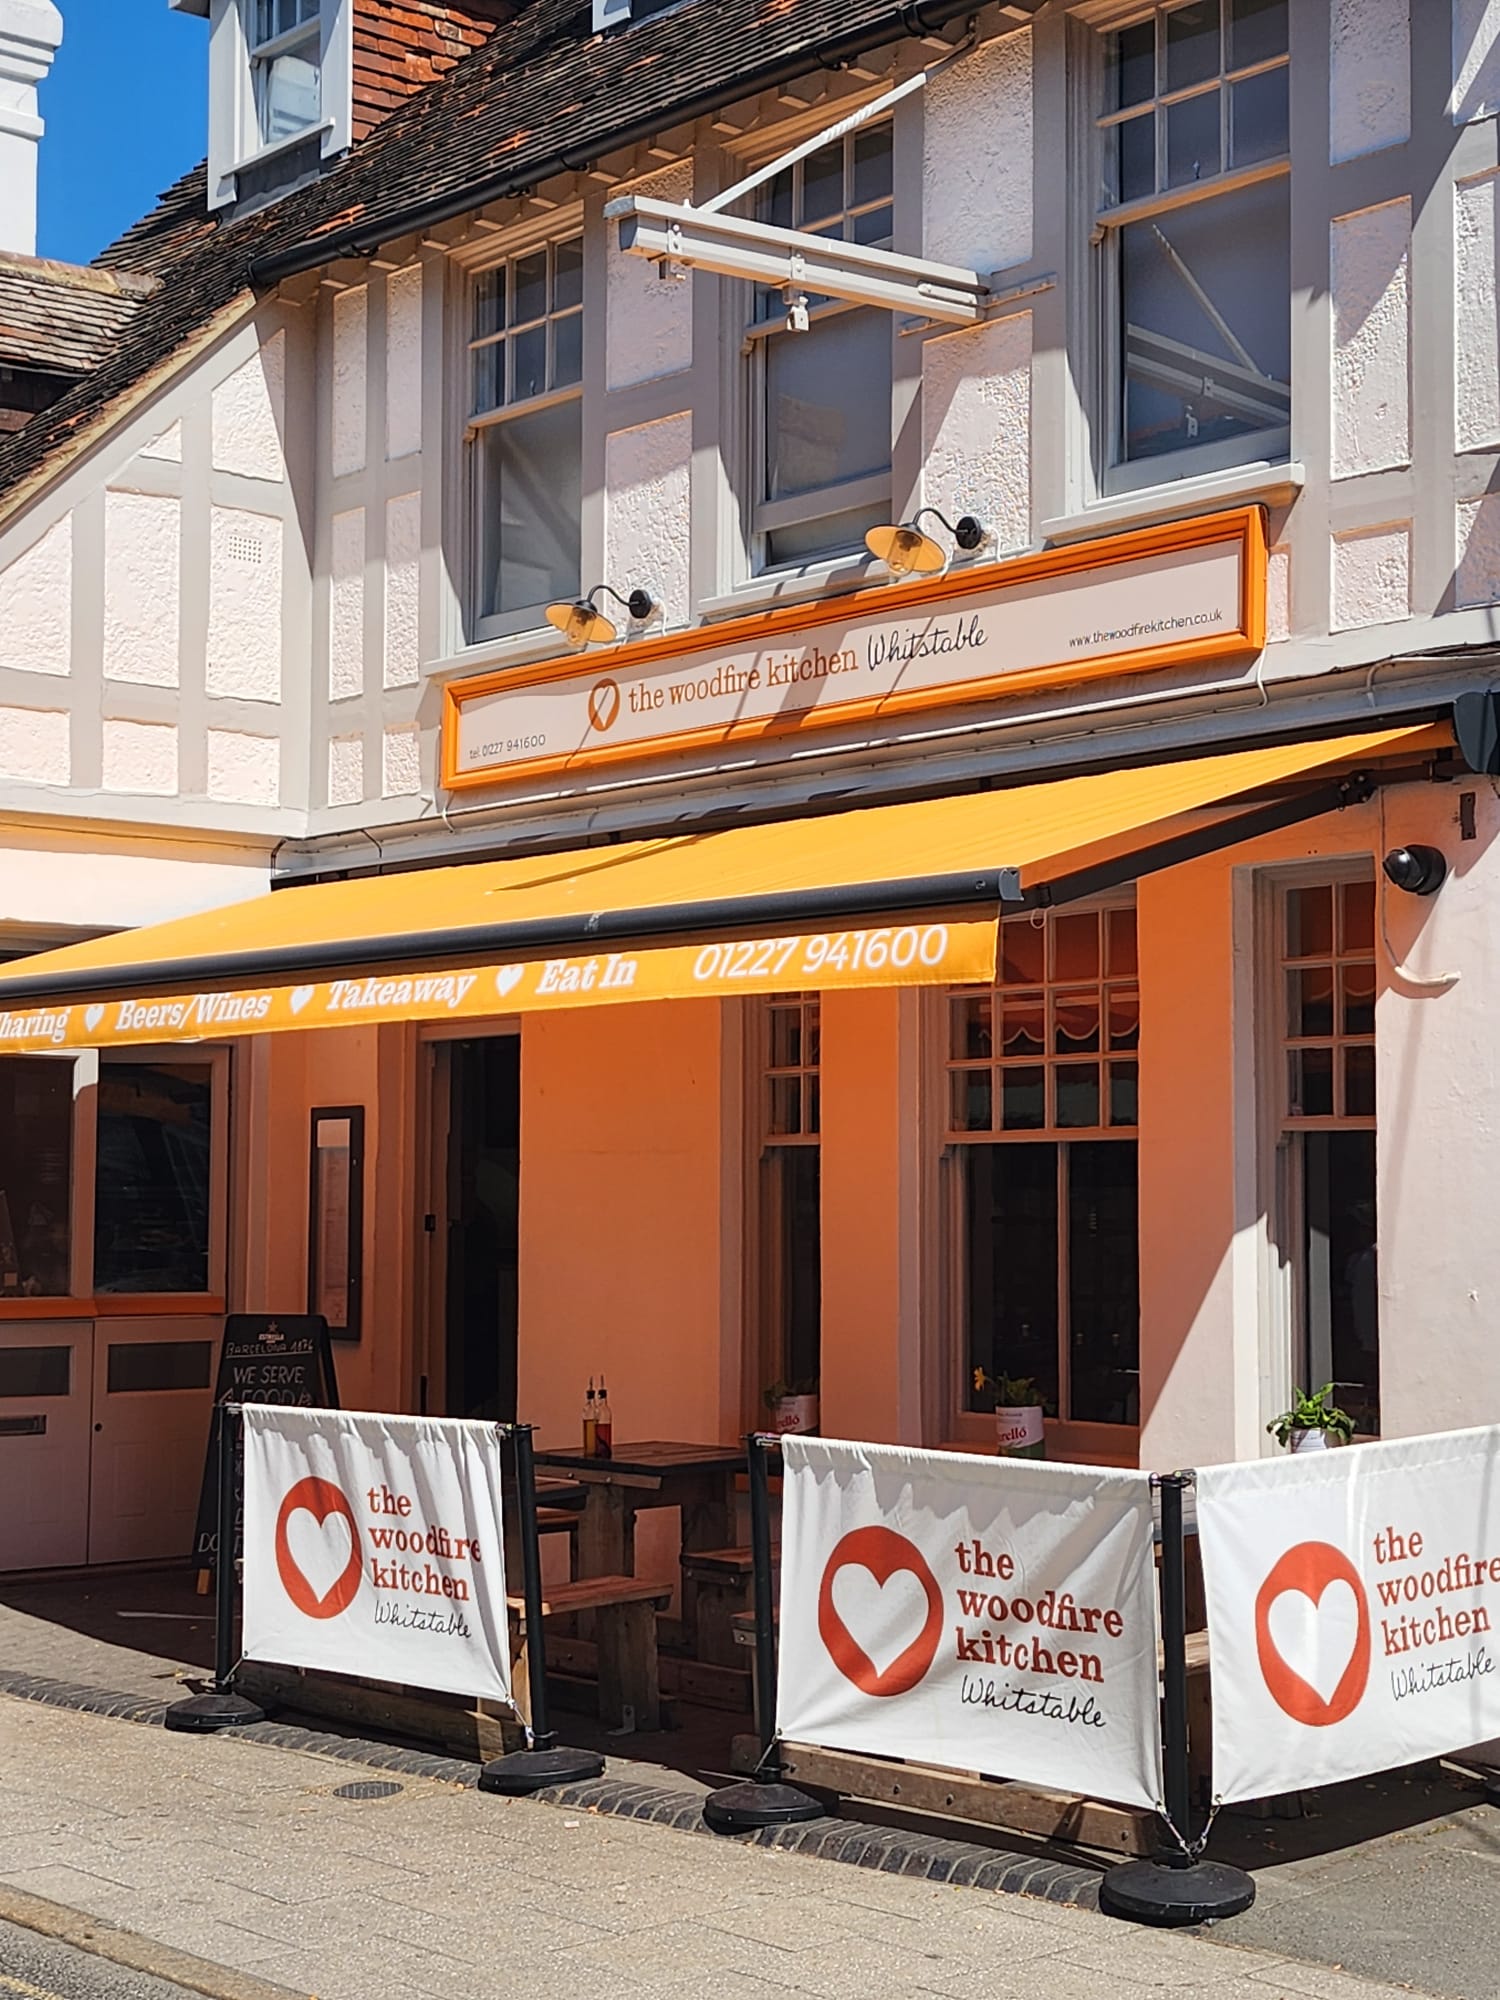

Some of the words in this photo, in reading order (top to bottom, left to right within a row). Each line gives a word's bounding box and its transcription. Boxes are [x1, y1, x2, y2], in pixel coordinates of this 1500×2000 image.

[628, 682, 665, 714] the
[668, 664, 761, 705] woodfire
[766, 647, 859, 687] kitchen
[867, 614, 989, 672] Whitstable
[507, 734, 546, 752] 941600
[0, 1009, 71, 1043] haring
[115, 992, 273, 1031] Beers/Wines
[326, 973, 477, 1011] Takeaway
[535, 958, 598, 995] Eat
[599, 953, 637, 988] In
[693, 937, 801, 981] 01227
[802, 924, 948, 974] 941600
[233, 1366, 257, 1385] WE
[260, 1365, 305, 1384] SERVE
[367, 1485, 411, 1517] the
[368, 1526, 482, 1562] woodfire
[954, 1540, 1014, 1580] the
[1373, 1526, 1423, 1565] the
[371, 1559, 469, 1601] kitchen
[1377, 1554, 1500, 1607] woodfire
[374, 1599, 473, 1638] Whitstable
[956, 1590, 1123, 1638] woodfire
[1381, 1606, 1491, 1656] kitchen
[956, 1627, 1104, 1683] kitchen
[1391, 1646, 1496, 1701] Whitstable
[961, 1675, 1106, 1727] Whitstable
